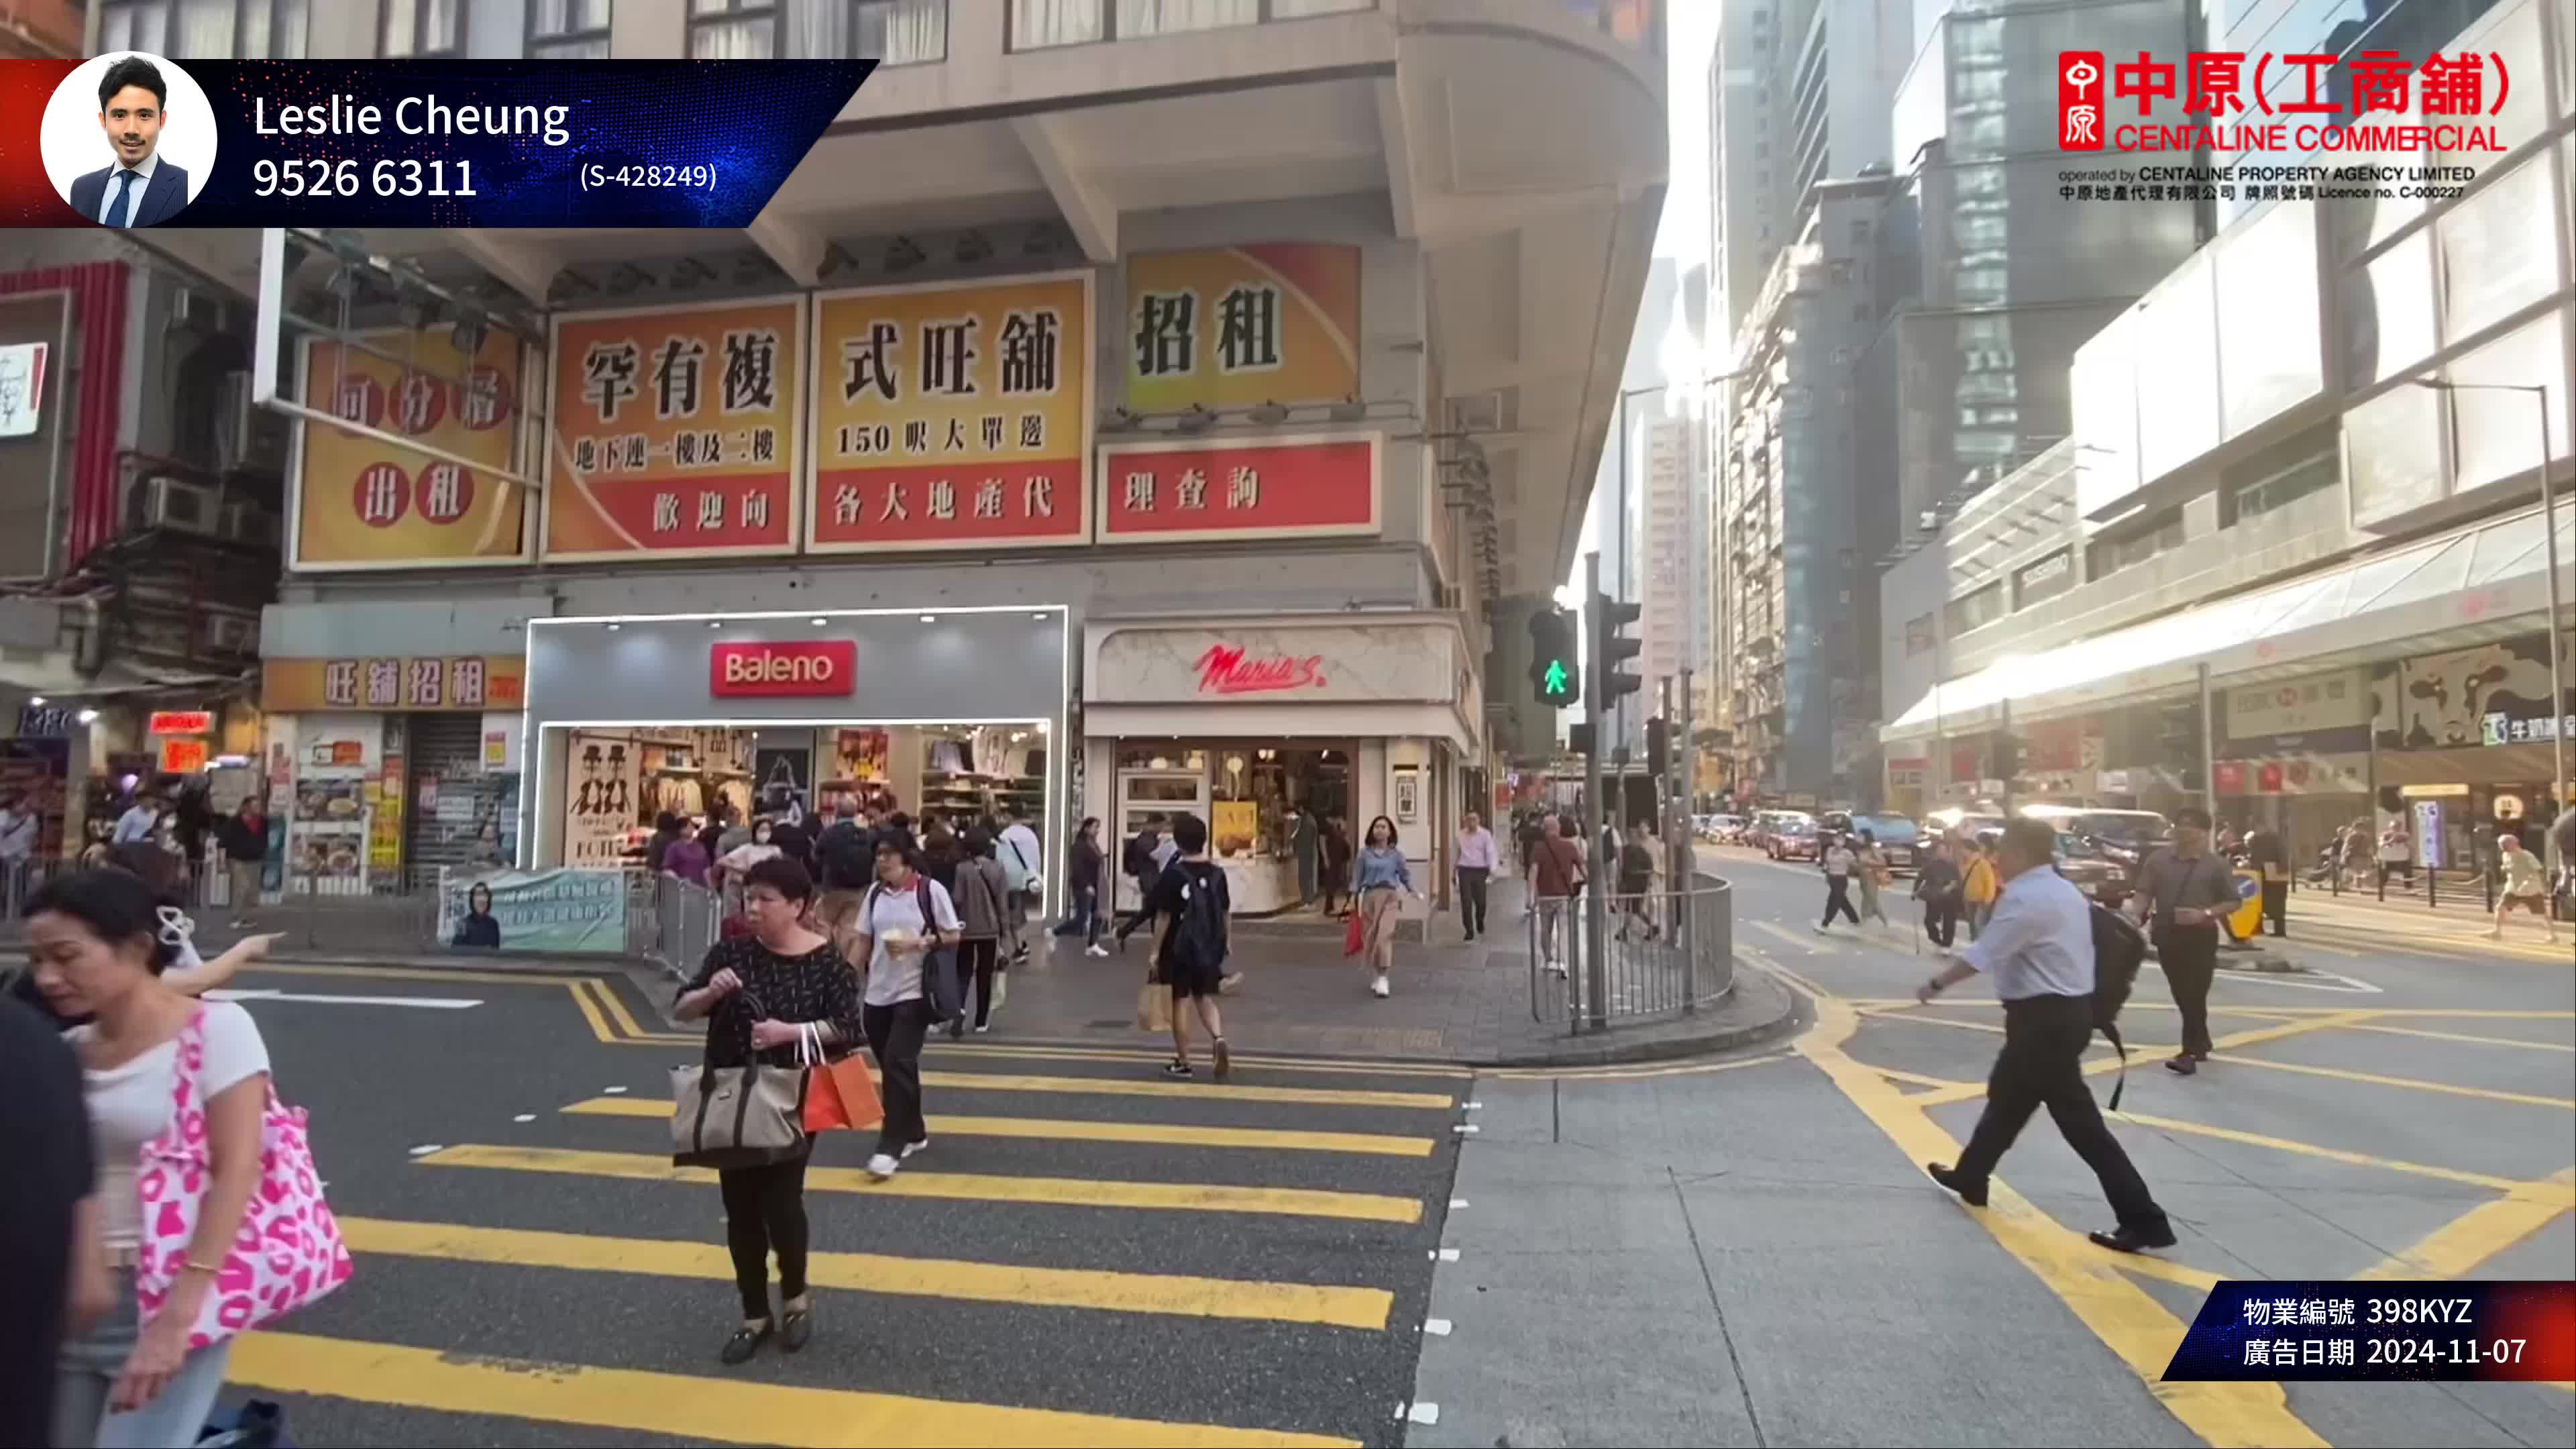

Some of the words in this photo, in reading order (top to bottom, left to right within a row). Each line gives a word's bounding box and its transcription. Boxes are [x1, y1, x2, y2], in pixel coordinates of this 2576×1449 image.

[1135, 288, 1278, 376] 招租
[586, 334, 775, 419] 罕有複
[574, 429, 774, 470] 地下連一樓及二樓
[364, 465, 460, 521] 出租
[834, 476, 1054, 526] 各大地產代
[1124, 466, 1260, 511] 理查詢
[725, 649, 834, 683] Baleno
